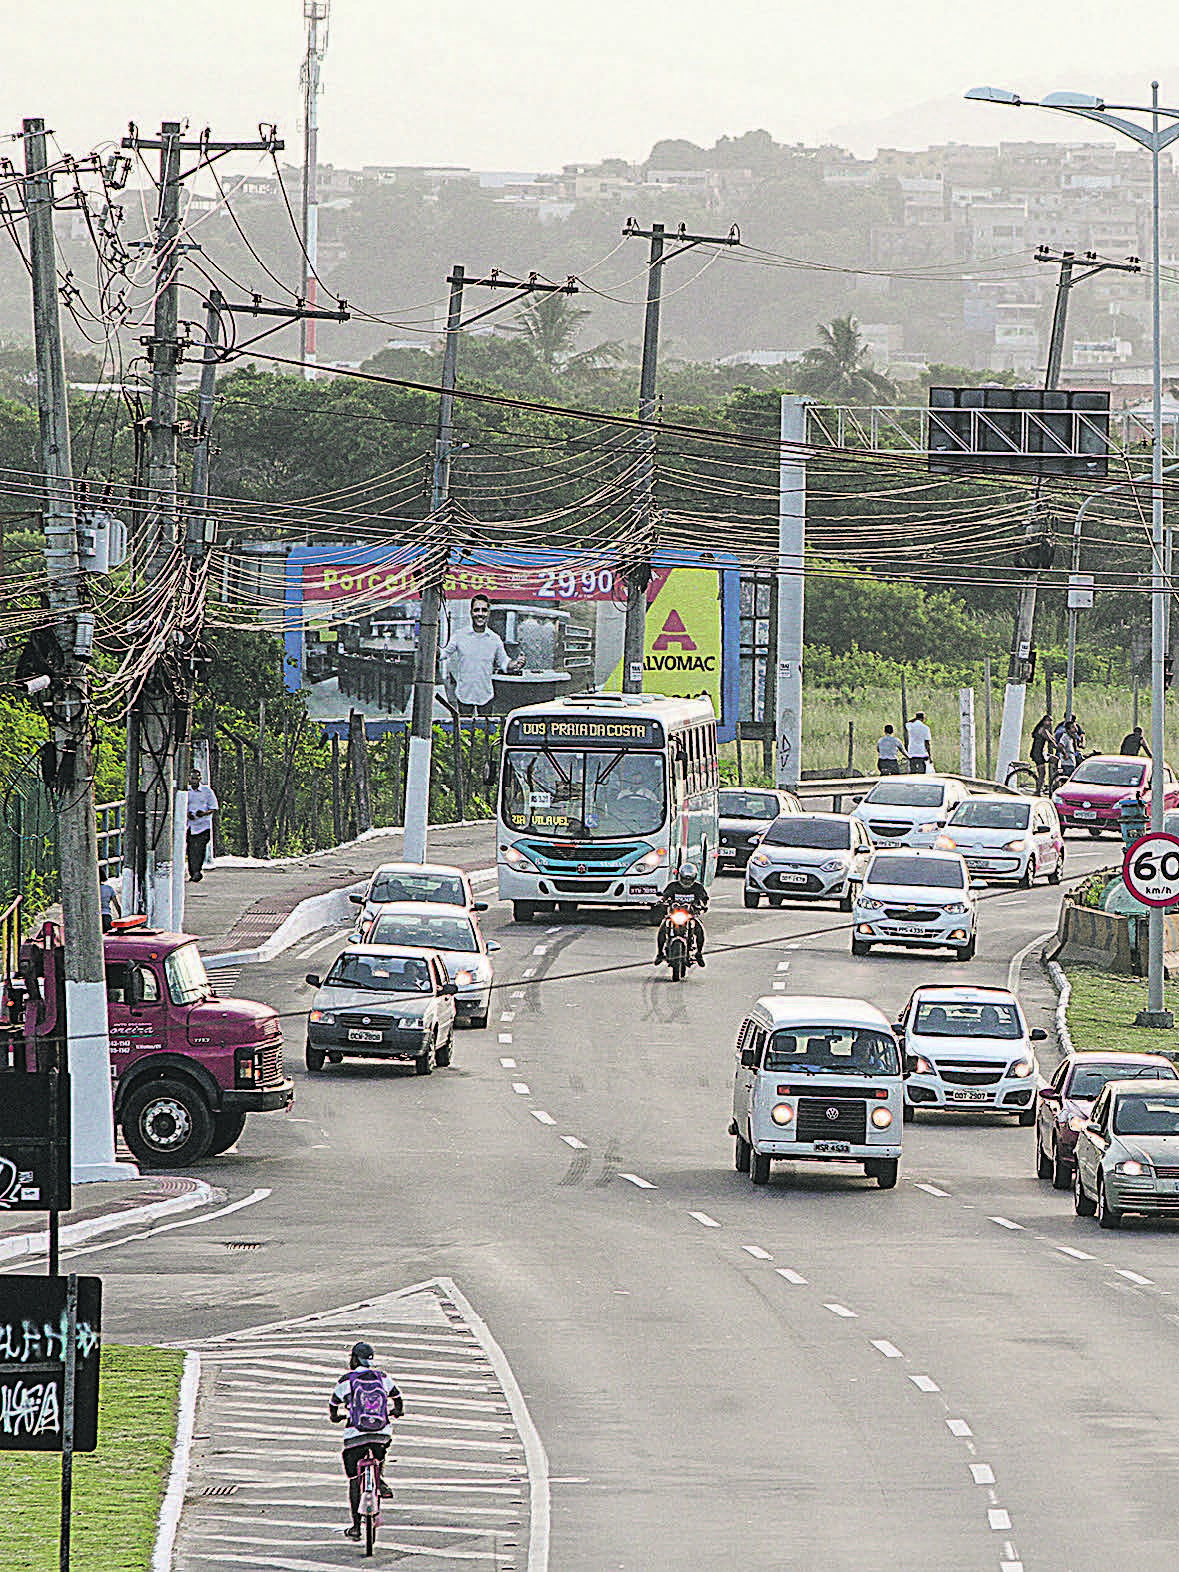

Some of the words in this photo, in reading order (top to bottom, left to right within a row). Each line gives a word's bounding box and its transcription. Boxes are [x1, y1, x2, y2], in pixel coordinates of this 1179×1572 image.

[550, 723, 589, 736] PRAIA
[589, 724, 606, 737] DA
[606, 724, 646, 738] COSTA
[1145, 886, 1172, 894] km/h
